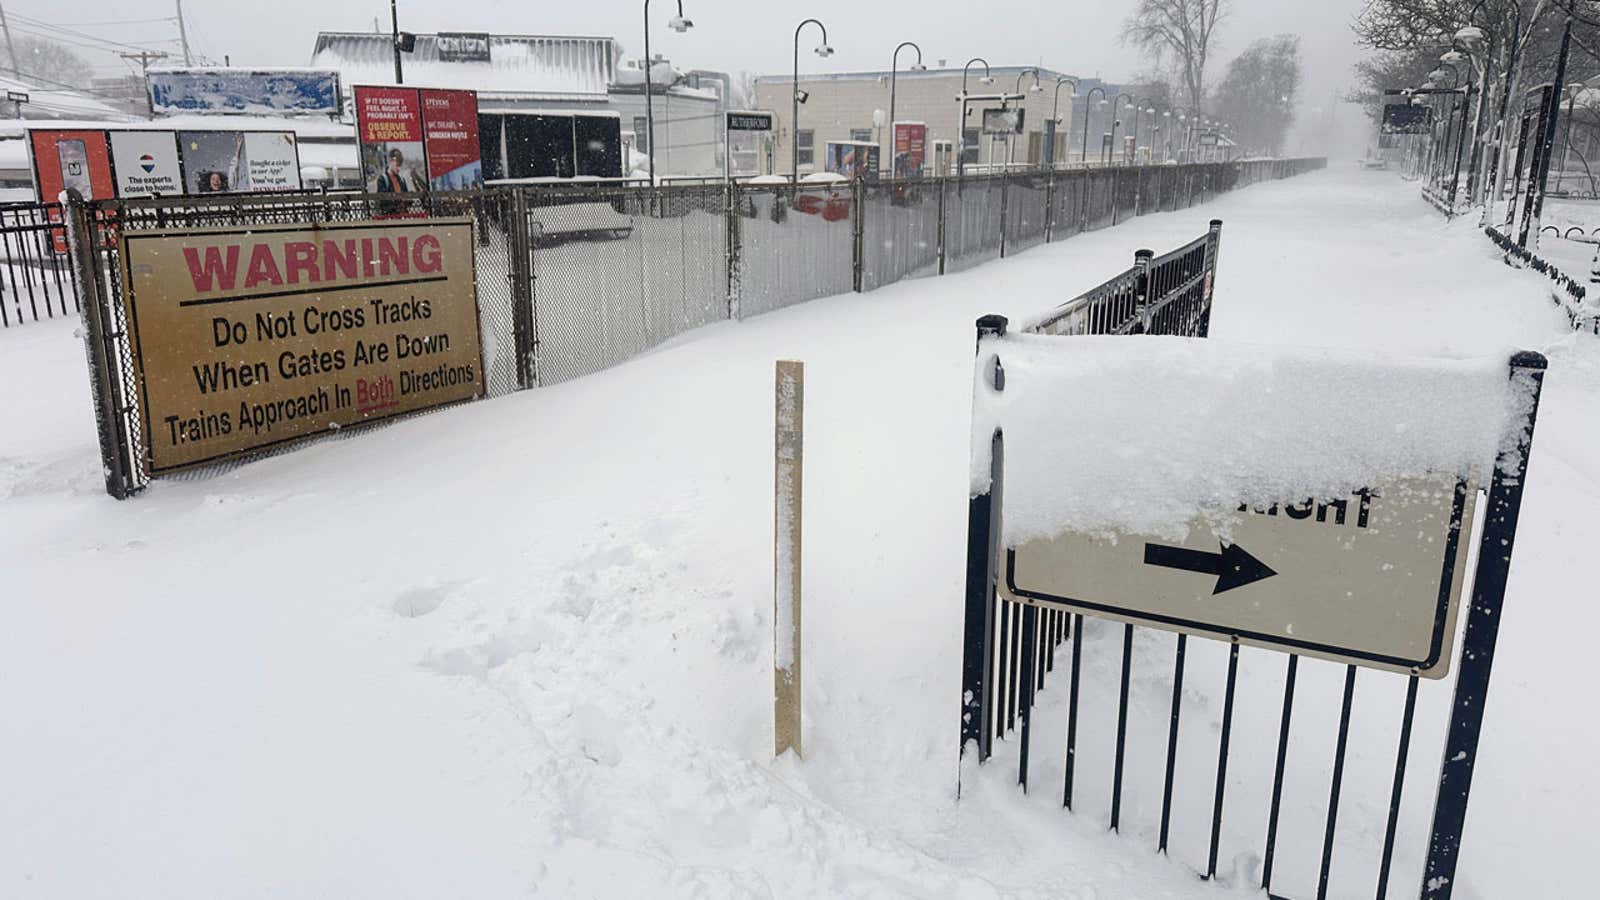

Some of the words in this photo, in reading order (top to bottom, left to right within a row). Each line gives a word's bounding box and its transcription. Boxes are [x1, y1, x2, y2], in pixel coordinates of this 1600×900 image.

[425, 97, 450, 106] STEVENS
[368, 122, 406, 131] OBSERVE
[368, 131, 375, 140] &
[377, 131, 411, 140] REPORT.
[143, 176, 172, 184] experts
[251, 176, 273, 184] You've
[182, 234, 443, 293] WARNING
[212, 316, 247, 347] Do
[255, 310, 297, 342] Not
[303, 305, 365, 335] Cross
[370, 296, 432, 324] Tracks
[192, 361, 270, 395] When
[277, 348, 346, 381] Gates
[353, 340, 389, 367] Are
[395, 332, 450, 359] Down
[164, 411, 232, 446] Trains
[238, 390, 330, 436] Approach
[334, 383, 351, 408] In
[356, 377, 394, 405] Both
[399, 362, 475, 396] Directions
[1237, 487, 1380, 528] GHT
